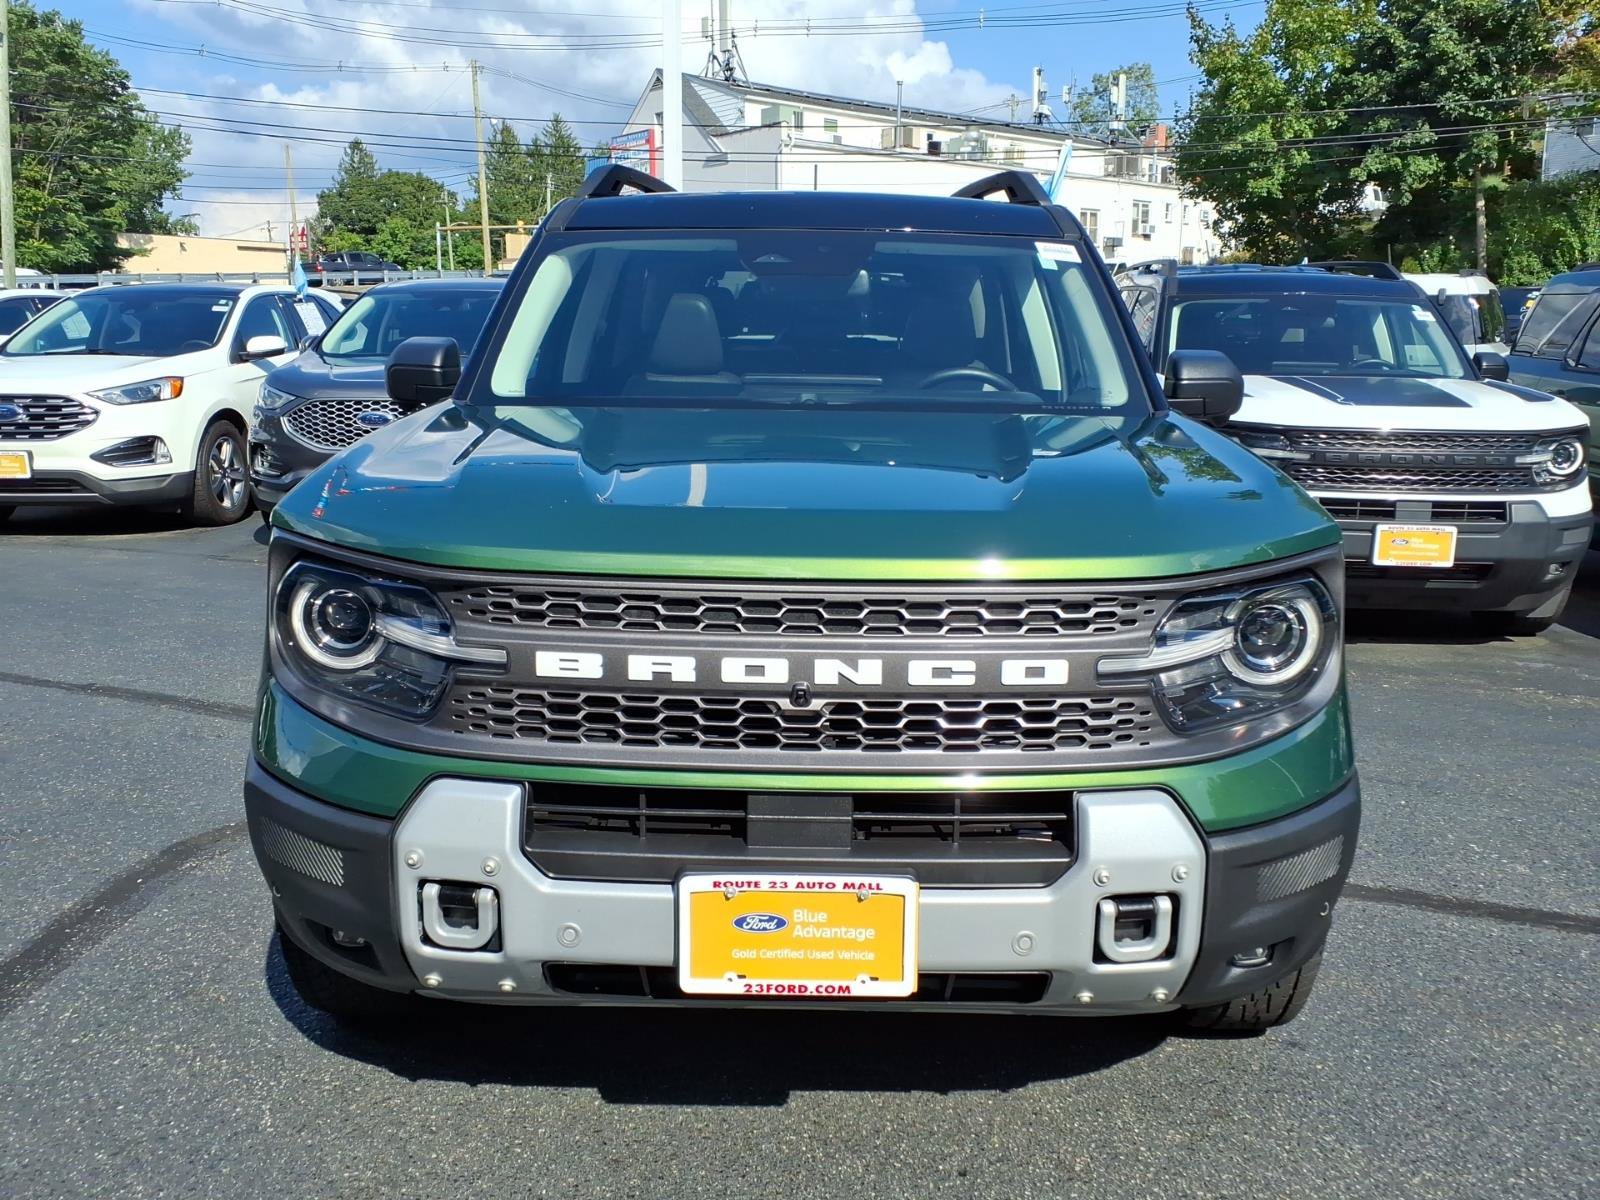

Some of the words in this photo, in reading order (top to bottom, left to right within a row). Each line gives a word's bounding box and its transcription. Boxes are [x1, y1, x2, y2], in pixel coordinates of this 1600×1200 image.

[1325, 452, 1507, 466] BRONCO
[535, 650, 1070, 687] BRONCO
[712, 880, 761, 890] ROUTE
[768, 881, 789, 890] 23
[795, 882, 837, 890] AUTO
[842, 882, 884, 891] MALL
[742, 914, 778, 930] Ford
[793, 908, 828, 923] Blue
[793, 926, 876, 942] Advantage
[732, 948, 757, 960] Gold
[759, 949, 804, 960] Certified
[807, 949, 834, 960] Used
[837, 950, 875, 961] Vehicle
[743, 983, 851, 995] 23FORD.COM
